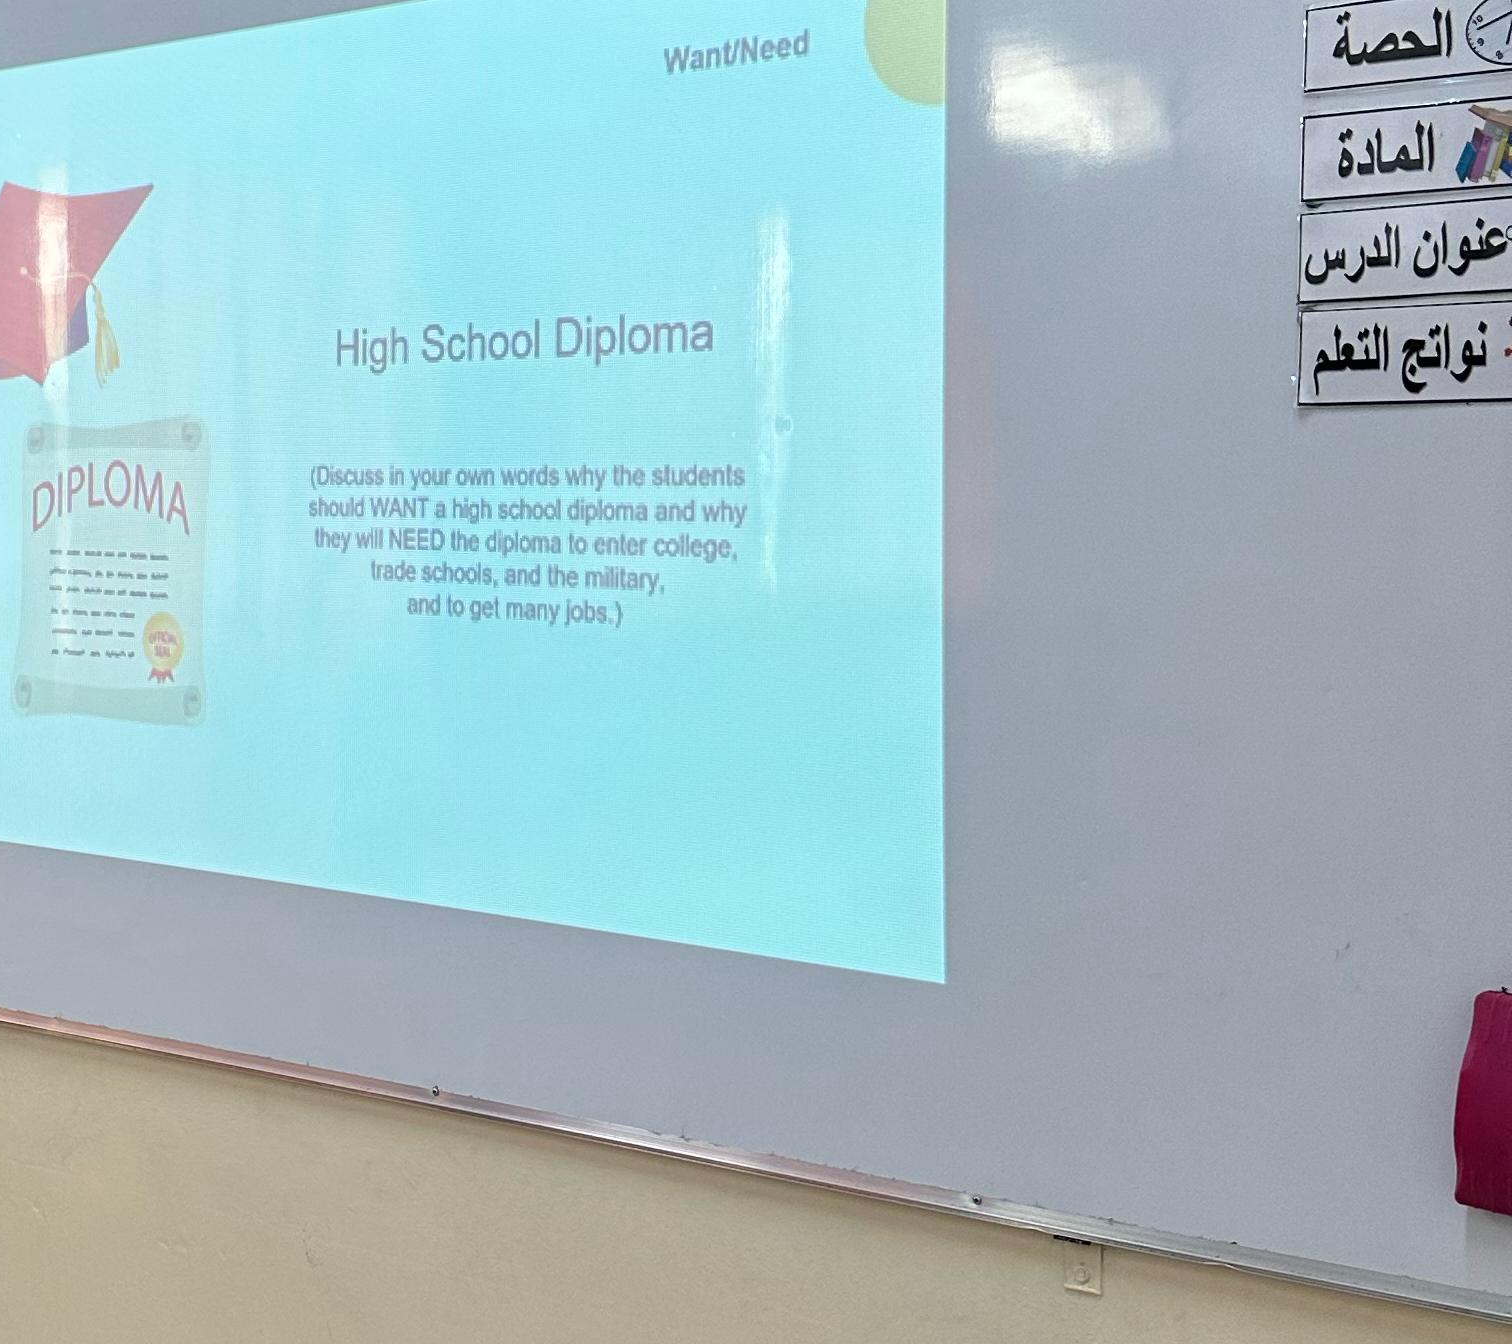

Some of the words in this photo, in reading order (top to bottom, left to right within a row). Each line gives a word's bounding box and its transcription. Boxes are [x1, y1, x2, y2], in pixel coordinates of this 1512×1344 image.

[664, 29, 810, 75] Want/Need
[1332, 6, 1453, 66] الحصة
[1337, 119, 1435, 179] المادة
[1304, 221, 1401, 285] الدرس
[1412, 217, 1507, 279] عنوان
[336, 327, 409, 374] High
[422, 318, 540, 363] School
[554, 313, 714, 366] Diploma
[1313, 322, 1389, 396] التعلم
[1400, 319, 1488, 394] نواتج
[32, 459, 190, 536] DIPLOMA
[311, 465, 385, 491] (Discuss
[389, 465, 405, 486] in
[410, 469, 452, 491] your
[456, 469, 495, 486] own
[501, 465, 560, 487] words
[565, 464, 606, 492] why
[614, 464, 645, 486] the
[652, 464, 746, 487] students
[308, 497, 365, 517] should
[370, 497, 429, 519] WANT
[434, 502, 448, 519] a
[452, 498, 493, 524] high
[498, 498, 562, 520] school
[568, 499, 648, 526] diploma
[656, 499, 696, 522] and
[702, 500, 748, 528] why
[315, 527, 351, 554] they
[356, 528, 384, 550] will
[389, 527, 446, 552] NEED
[450, 528, 480, 553] the
[485, 529, 562, 559] diploma
[568, 532, 587, 554] to
[594, 533, 648, 556] enter
[654, 532, 738, 564] college,
[370, 559, 417, 582] trade
[422, 561, 498, 588] schools,
[504, 563, 541, 587] and
[548, 563, 580, 588] the
[585, 565, 665, 596] military,
[407, 593, 441, 616] and
[446, 594, 465, 617] to
[470, 596, 500, 623] get
[506, 599, 561, 627] many
[565, 598, 624, 629] jobs.)
